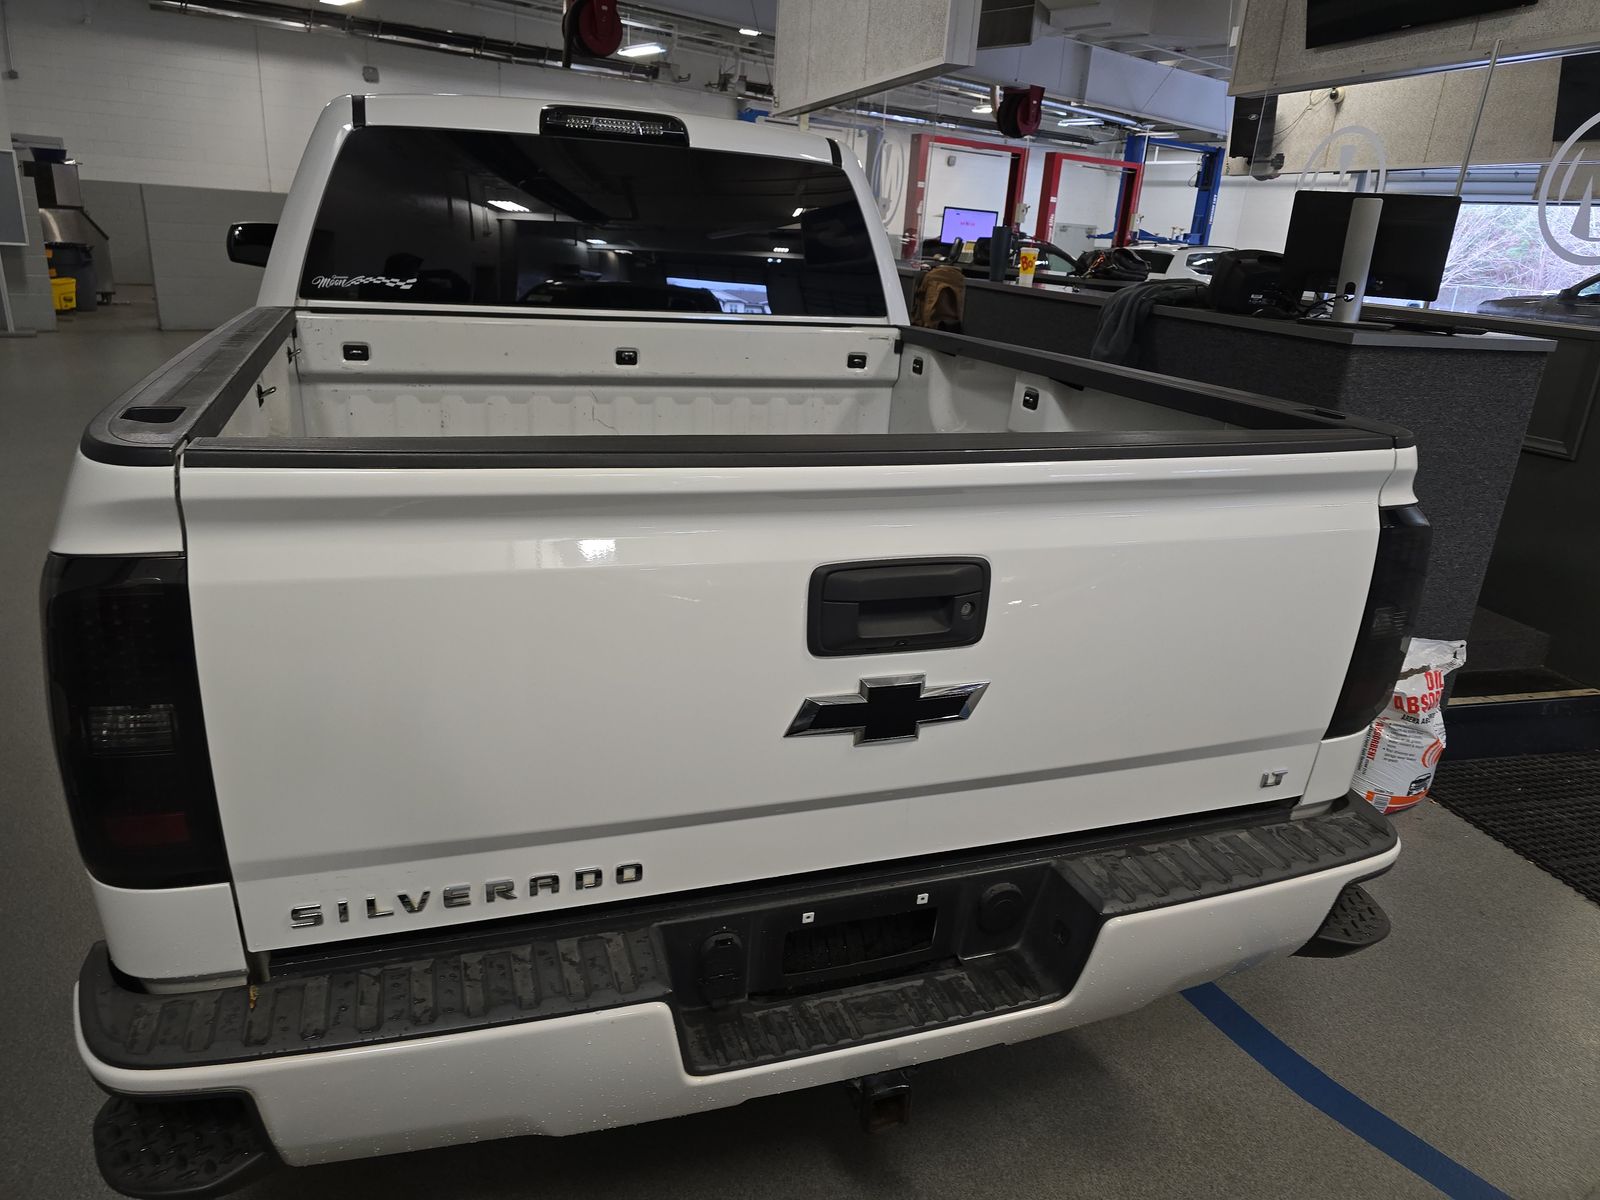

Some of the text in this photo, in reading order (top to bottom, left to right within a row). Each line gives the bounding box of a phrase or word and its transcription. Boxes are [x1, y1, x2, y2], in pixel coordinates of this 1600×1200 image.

[1424, 670, 1445, 691] OIL
[1259, 769, 1289, 789] LT
[290, 861, 645, 929] SILVERADO
